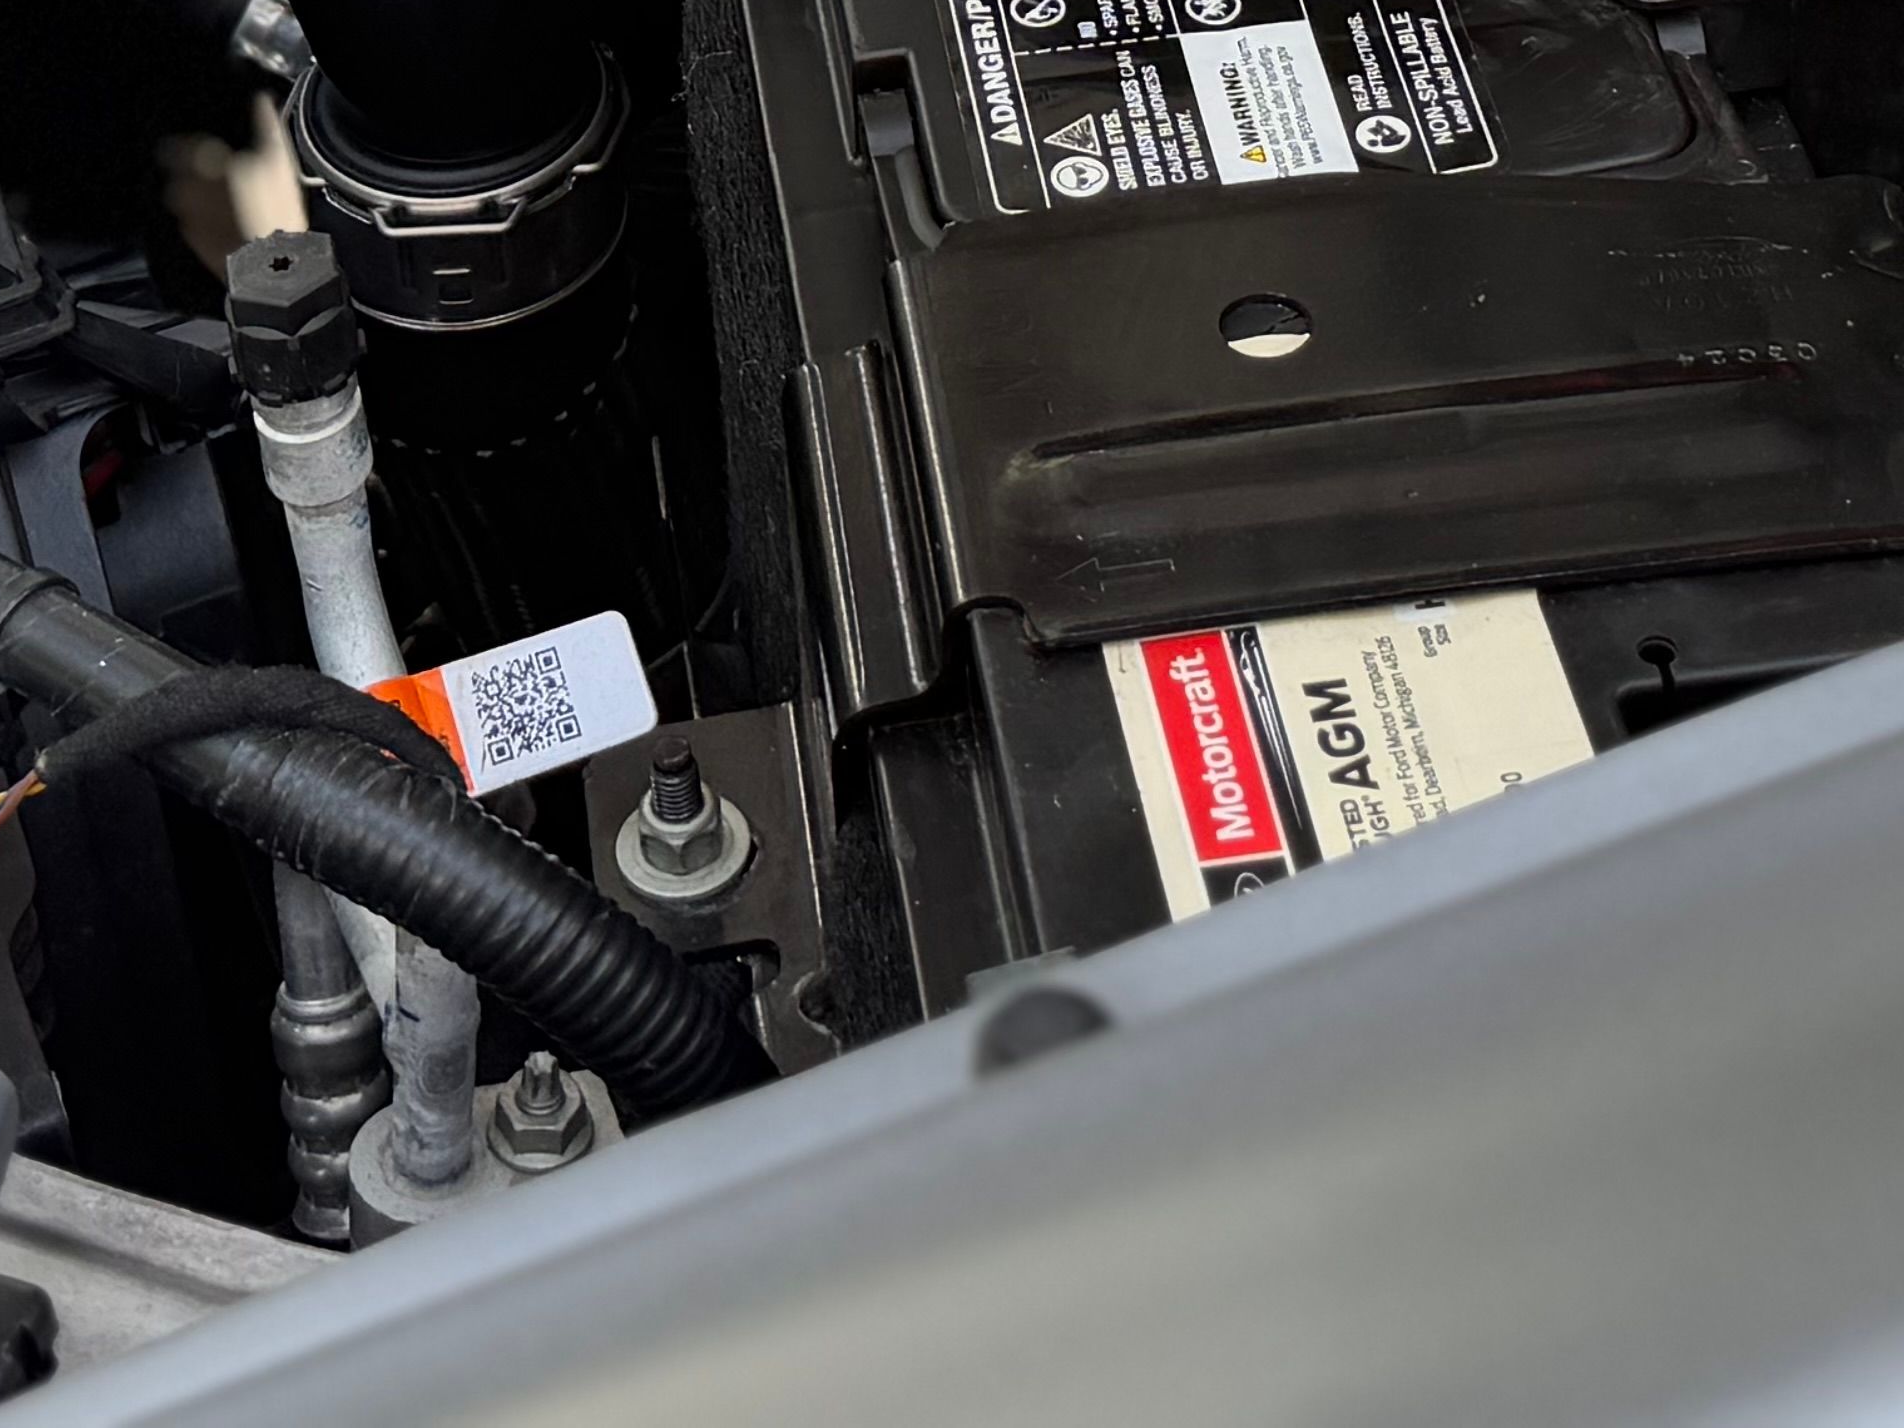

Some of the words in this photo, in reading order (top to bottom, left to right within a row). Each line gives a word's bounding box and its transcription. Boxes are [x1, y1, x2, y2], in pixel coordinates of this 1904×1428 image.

[1347, 12, 1392, 109] INSTRUCTIONS.
[1418, 17, 1448, 64] Battery
[1115, 50, 1136, 78] CAN
[1389, 10, 1455, 145] NON-SPILLABLE
[1434, 66, 1461, 97] Acid
[1120, 79, 1147, 119] GASES
[1141, 64, 1175, 138] BLINDNESS
[1219, 62, 1262, 147] WARNING:
[1347, 74, 1373, 112] READ
[1175, 108, 1204, 159] INJURY.
[1446, 98, 1474, 134] Lead
[1110, 146, 1138, 190] SHIELD
[1131, 120, 1166, 186] EXPLOSIVE
[1162, 139, 1188, 184] CAUSE
[1190, 160, 1209, 181] OR
[1287, 143, 1307, 169] Wash
[1417, 625, 1439, 659] Group
[1361, 650, 1391, 710] Company
[1391, 671, 1420, 730] Michigan
[1168, 652, 1256, 841] Motorcraft
[1301, 678, 1380, 790] AGM
[1381, 710, 1403, 749] Motor
[1389, 746, 1414, 781] Ford
[1402, 782, 1420, 801] for
